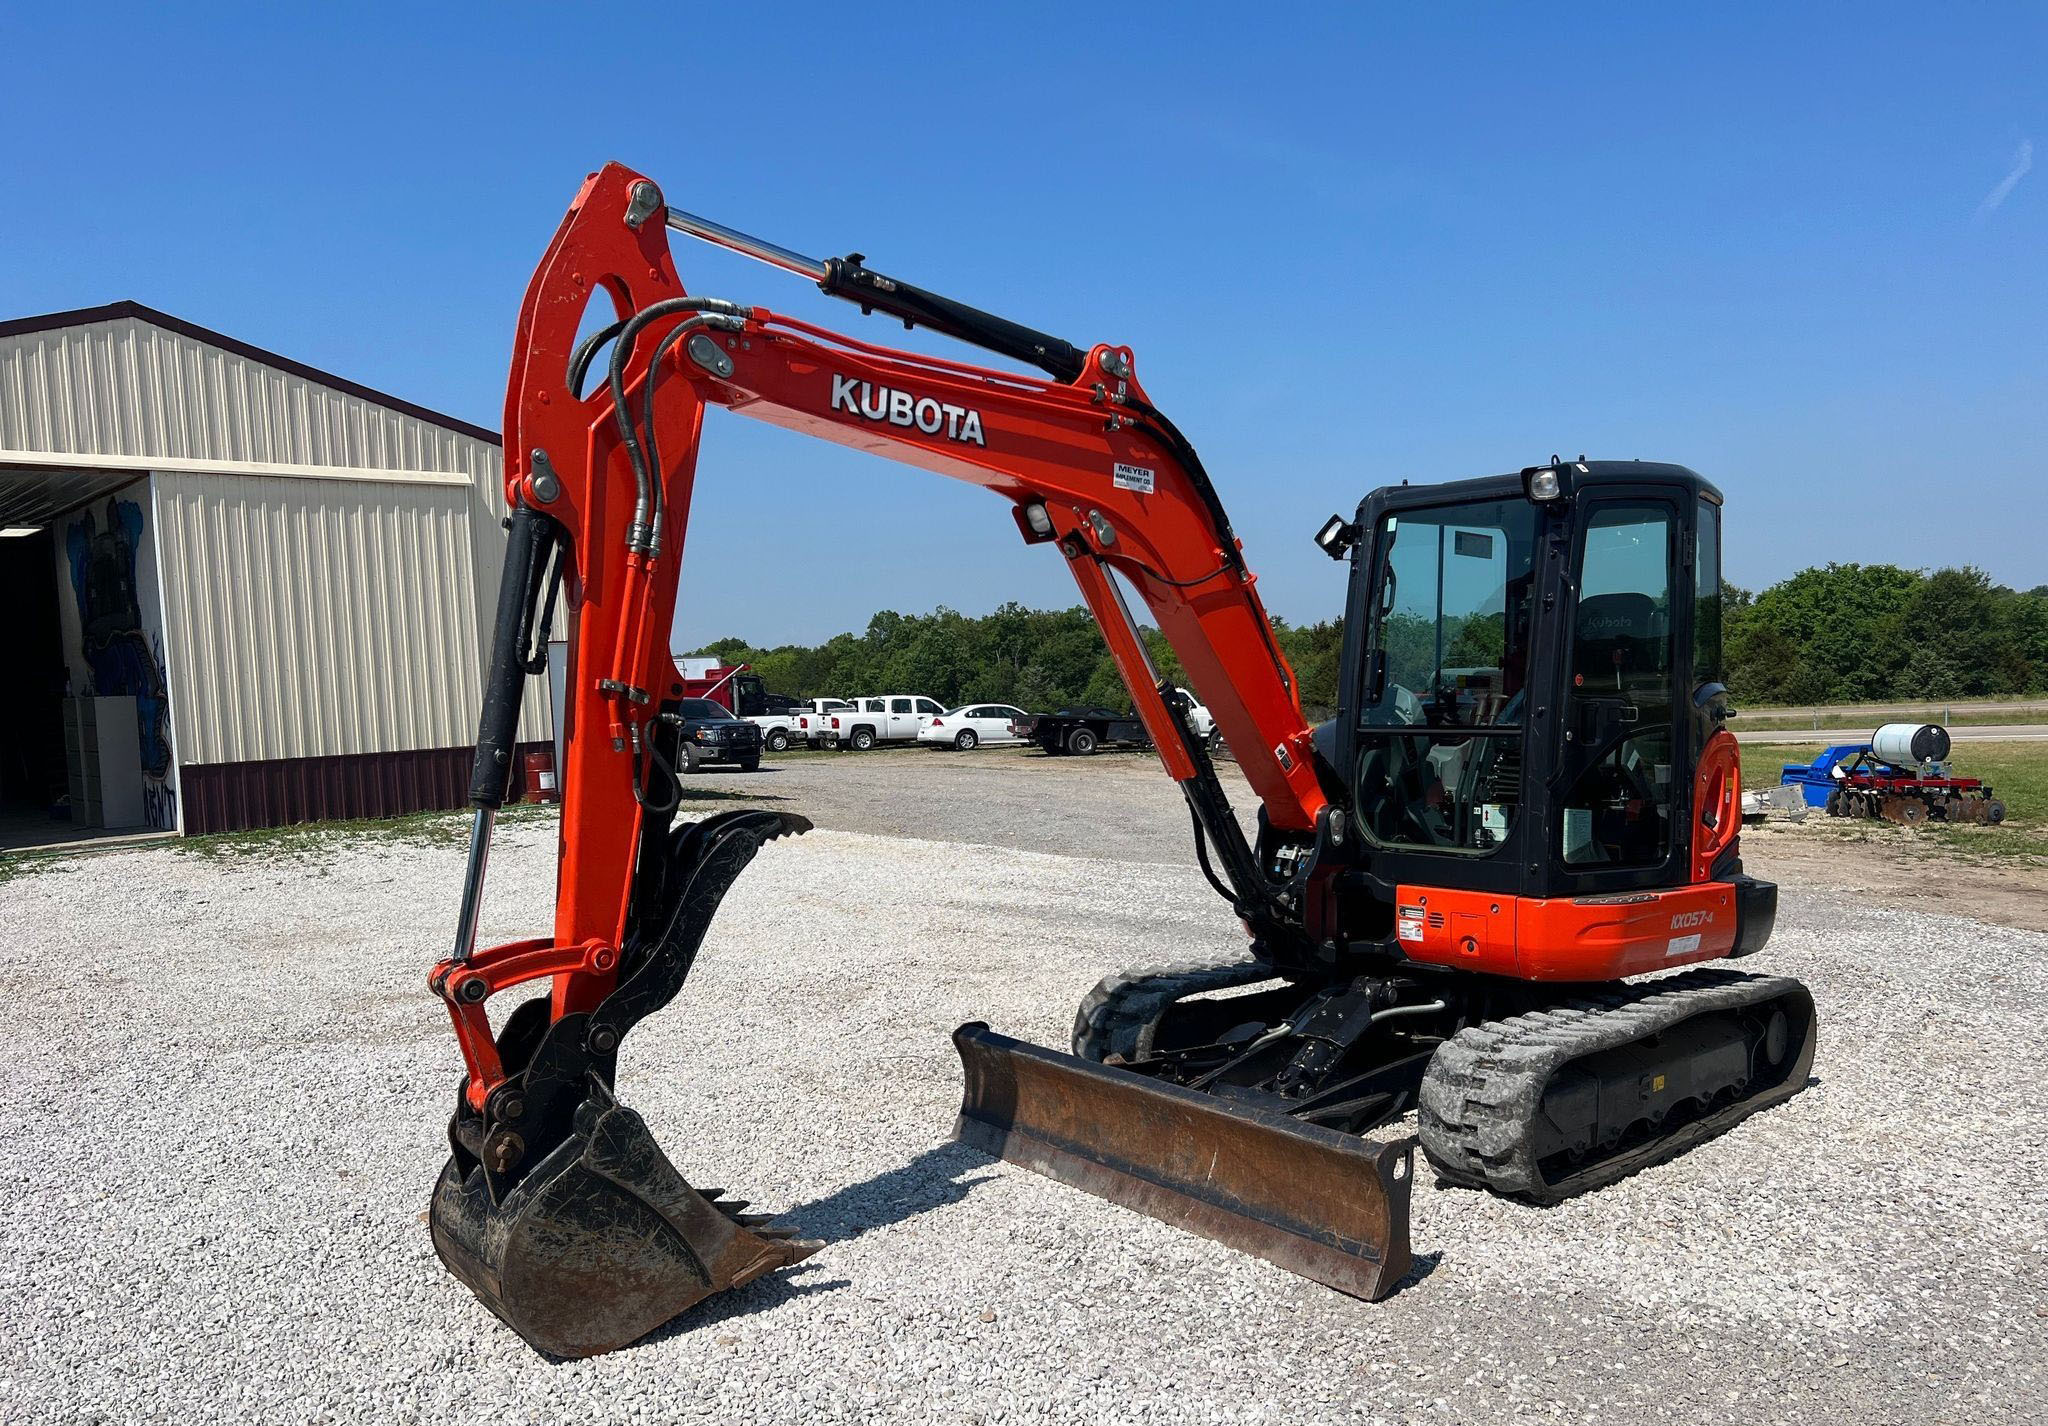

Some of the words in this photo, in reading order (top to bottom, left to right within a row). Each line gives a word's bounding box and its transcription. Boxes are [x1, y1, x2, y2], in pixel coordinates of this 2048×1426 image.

[831, 373, 985, 446] KUBOTA
[1118, 464, 1150, 478] MEYER
[1588, 616, 1633, 630] Kubota
[1670, 910, 1714, 930] KX057-4
